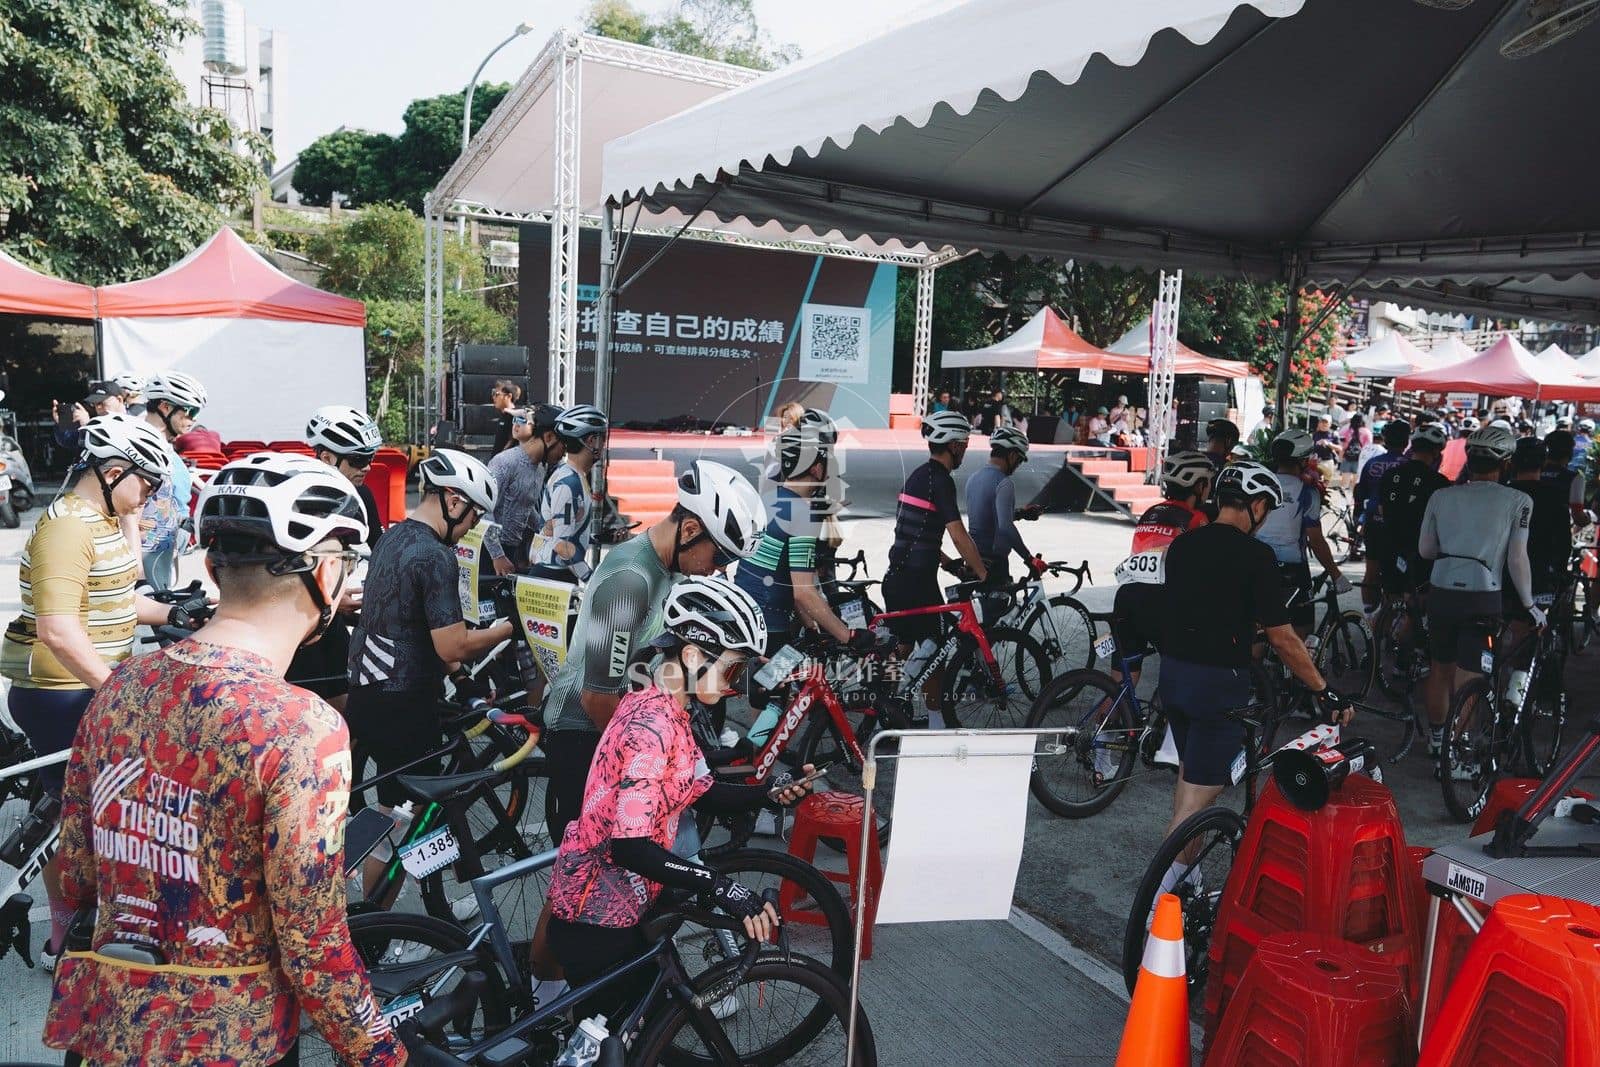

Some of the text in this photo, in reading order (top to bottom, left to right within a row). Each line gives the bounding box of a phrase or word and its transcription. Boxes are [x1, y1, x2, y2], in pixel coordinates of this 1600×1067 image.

[549, 306, 785, 344] 查自己的成績
[1129, 556, 1158, 573] 503
[611, 633, 628, 675] MAAP
[1101, 639, 1115, 655] 503
[755, 695, 811, 780] cervélo
[146, 771, 203, 820] STEVE
[118, 798, 199, 852] TILFORD
[92, 823, 200, 884] FOUNDATION
[114, 912, 160, 928] ZIPP
[116, 893, 159, 913] SRAM
